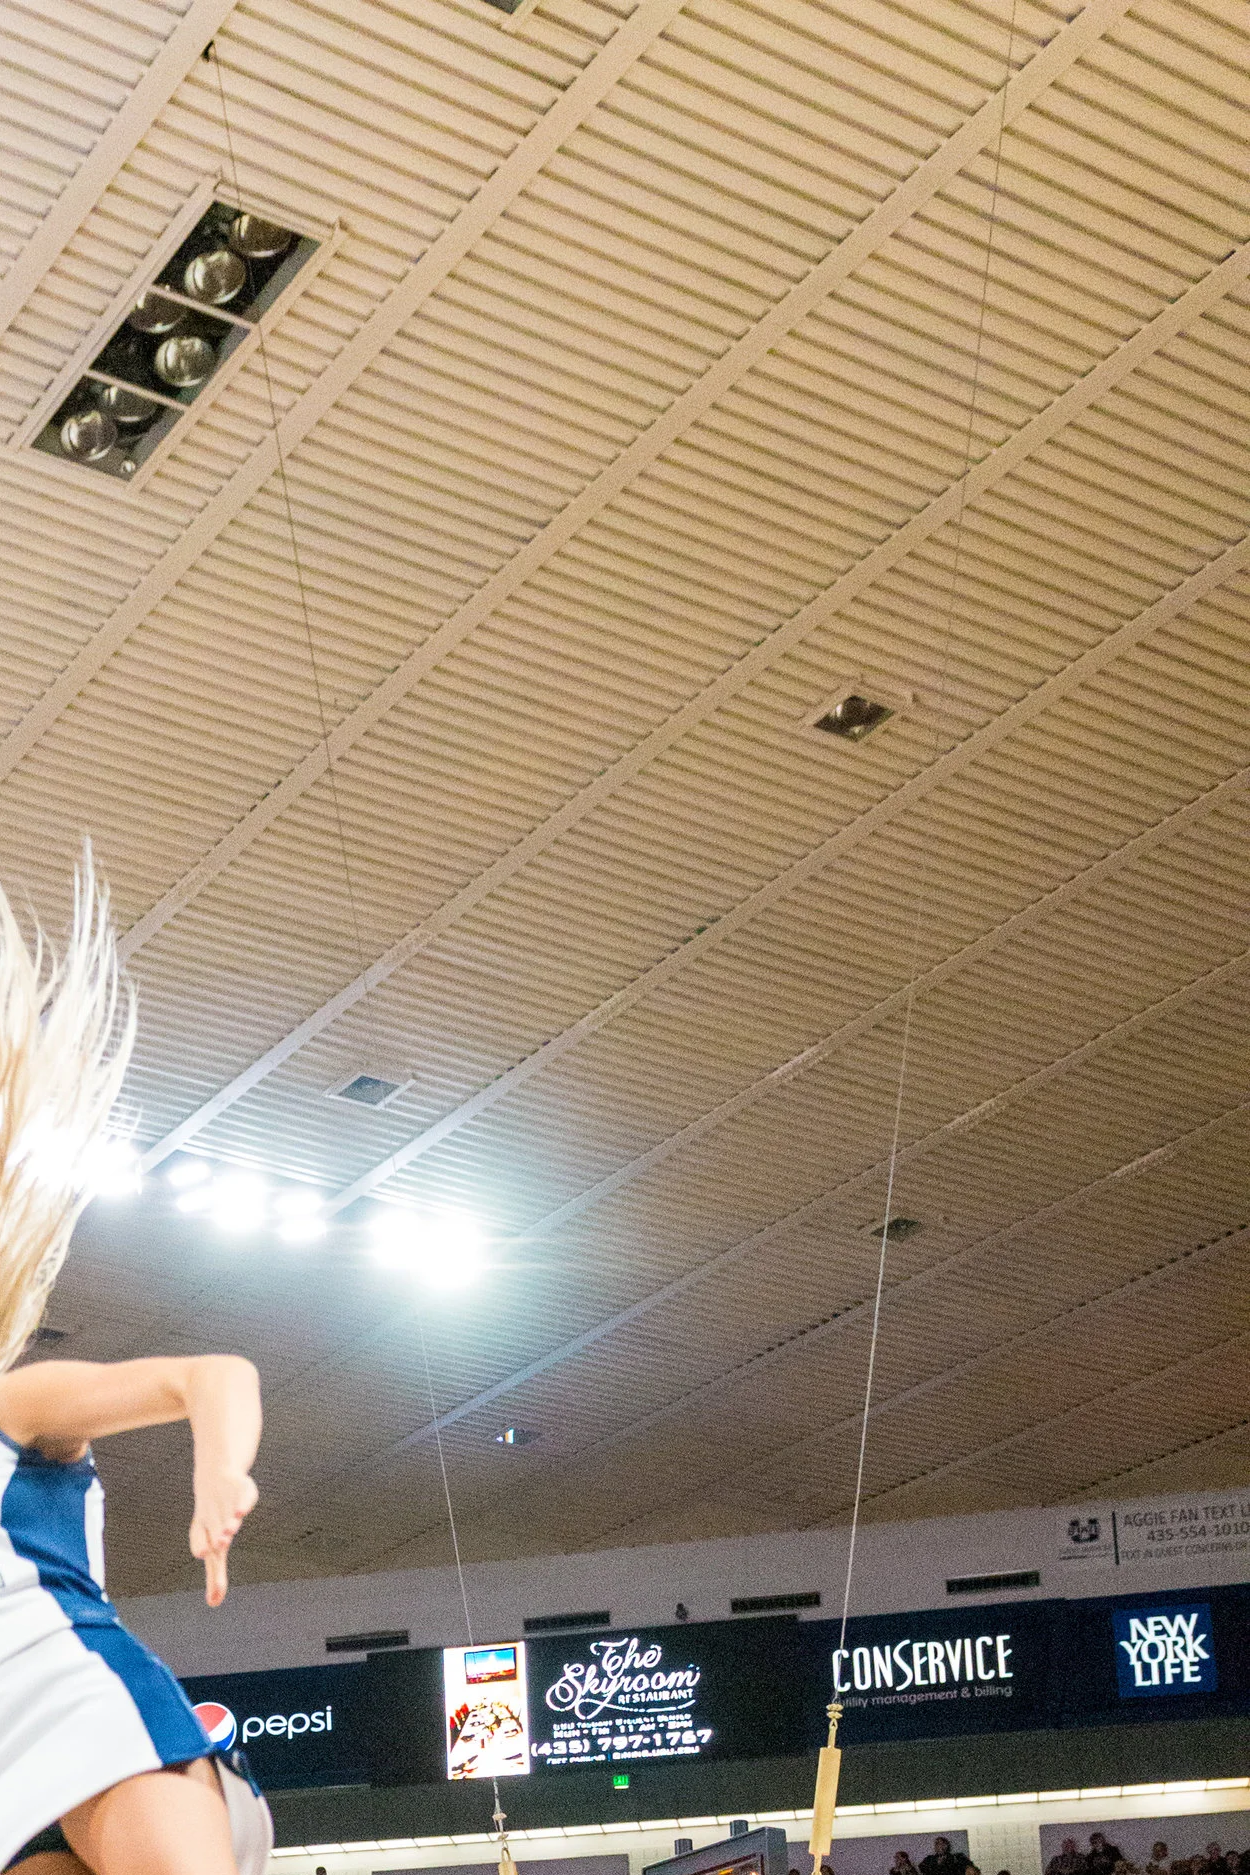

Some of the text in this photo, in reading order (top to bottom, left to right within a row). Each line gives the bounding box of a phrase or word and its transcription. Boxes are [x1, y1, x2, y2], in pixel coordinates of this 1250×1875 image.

[1123, 1511, 1167, 1528] AGGIE
[1170, 1508, 1199, 1523] FAN
[1203, 1503, 1236, 1519] TEXT
[1128, 1613, 1199, 1644] NEW
[589, 1637, 662, 1680] The
[832, 1635, 1014, 1693] CONSERVICE
[1119, 1633, 1210, 1666] YORK
[1134, 1656, 1202, 1687] LIFE
[545, 1662, 701, 1720] Skyroom
[871, 1689, 958, 1706] management
[960, 1686, 972, 1698] &
[974, 1685, 1013, 1698] billing
[242, 1705, 332, 1743] pepsi
[530, 1728, 713, 1757] (435) 797-1767
